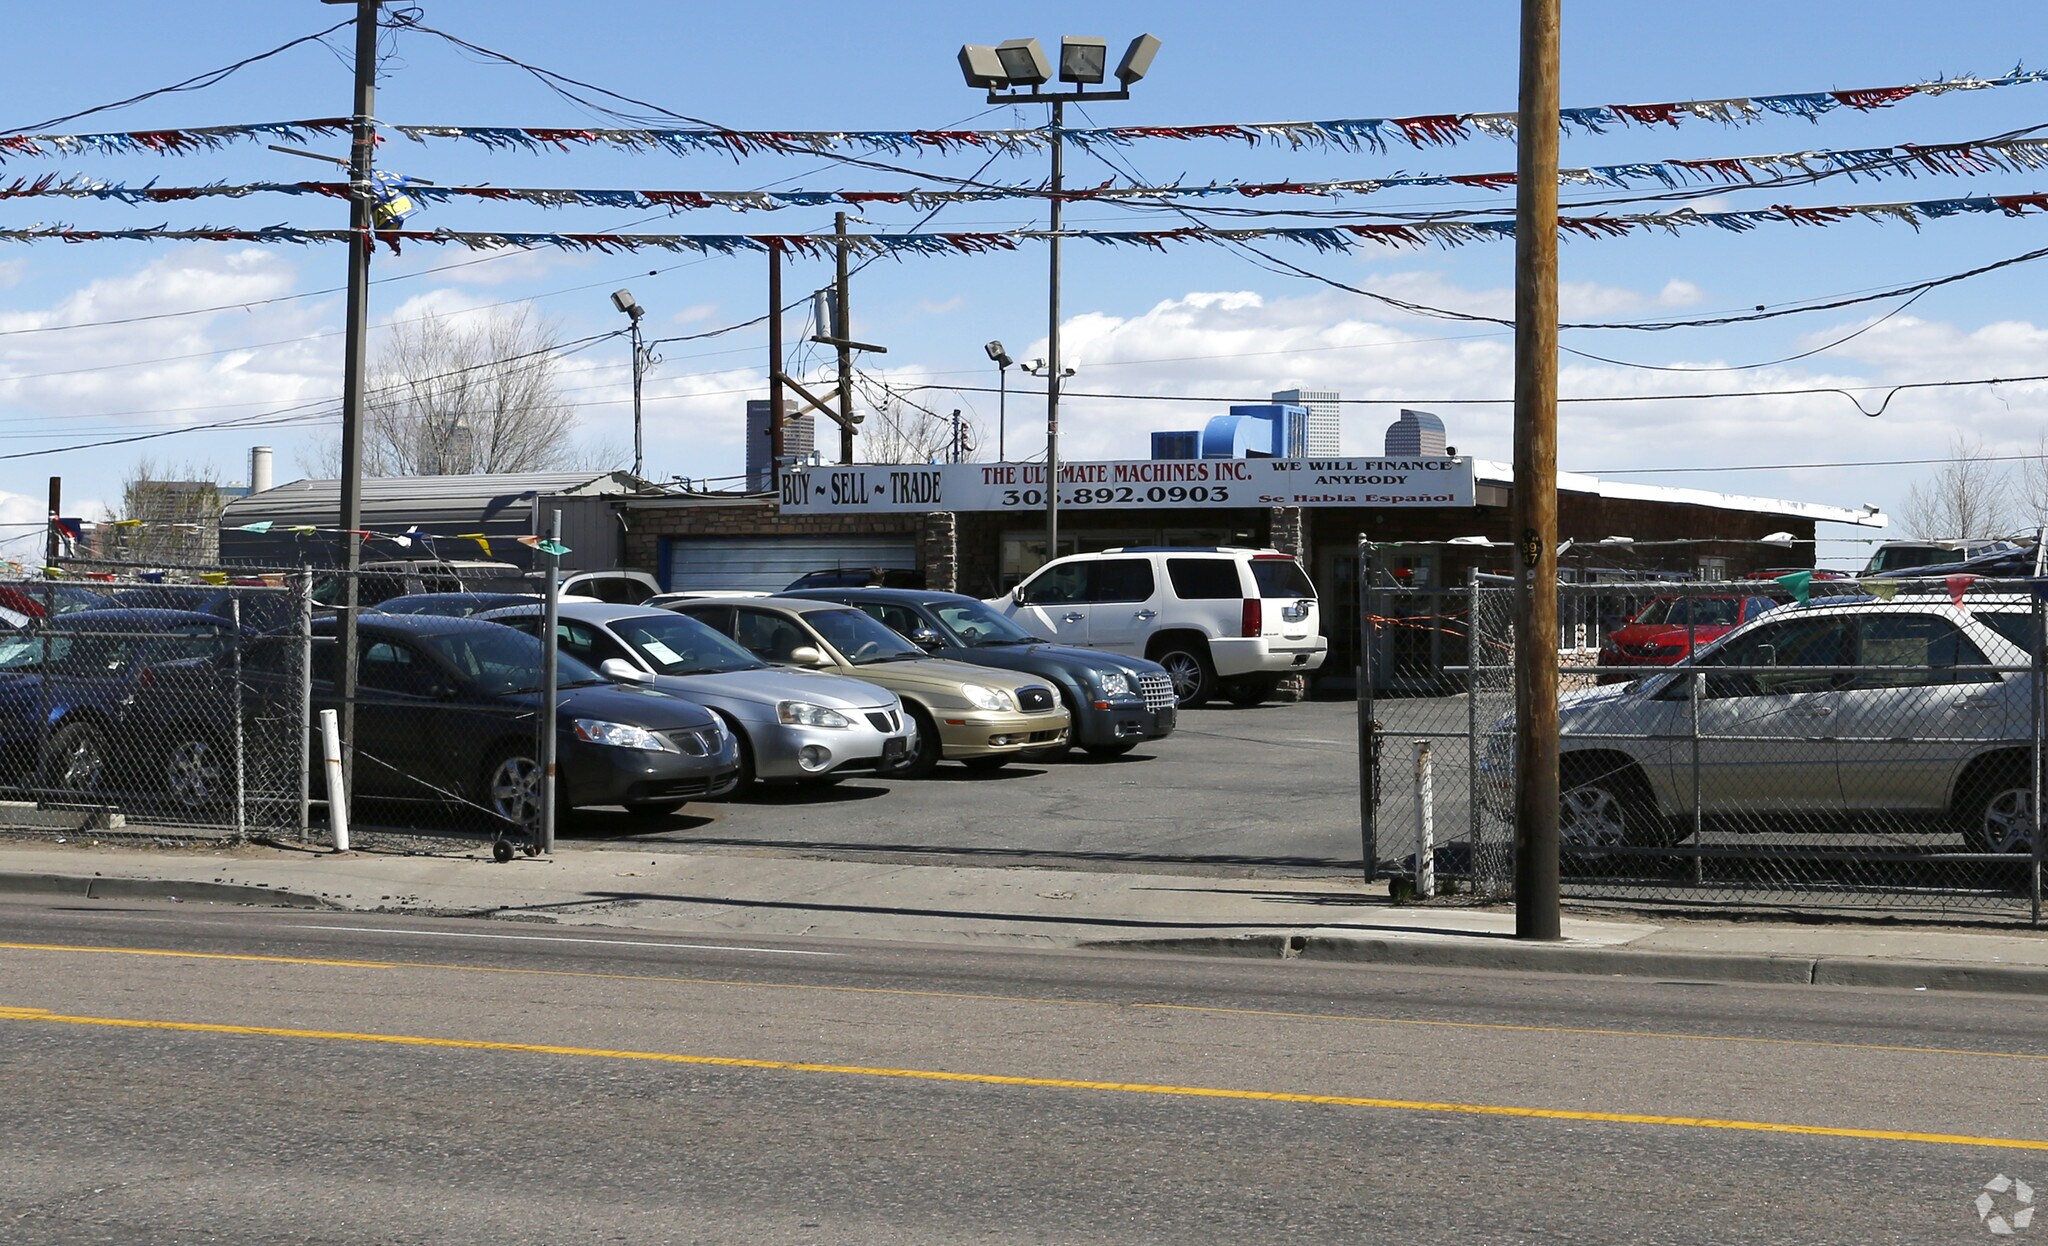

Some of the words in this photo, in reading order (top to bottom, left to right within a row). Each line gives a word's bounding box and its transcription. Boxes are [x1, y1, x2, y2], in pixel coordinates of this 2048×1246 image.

[1271, 461, 1302, 471] WE
[1309, 461, 1358, 471] WILL
[1365, 461, 1453, 471] FINANCE
[981, 467, 1017, 485] THE
[1114, 463, 1209, 483] MACHINES
[1215, 462, 1252, 481] INC.
[1315, 475, 1409, 485] ANYBODY
[781, 473, 811, 505] BUY
[831, 472, 869, 505] SELL
[890, 471, 942, 504] TRADE
[1258, 494, 1284, 503] Se
[1293, 494, 1357, 503] Habla
[1365, 493, 1455, 504] Español
